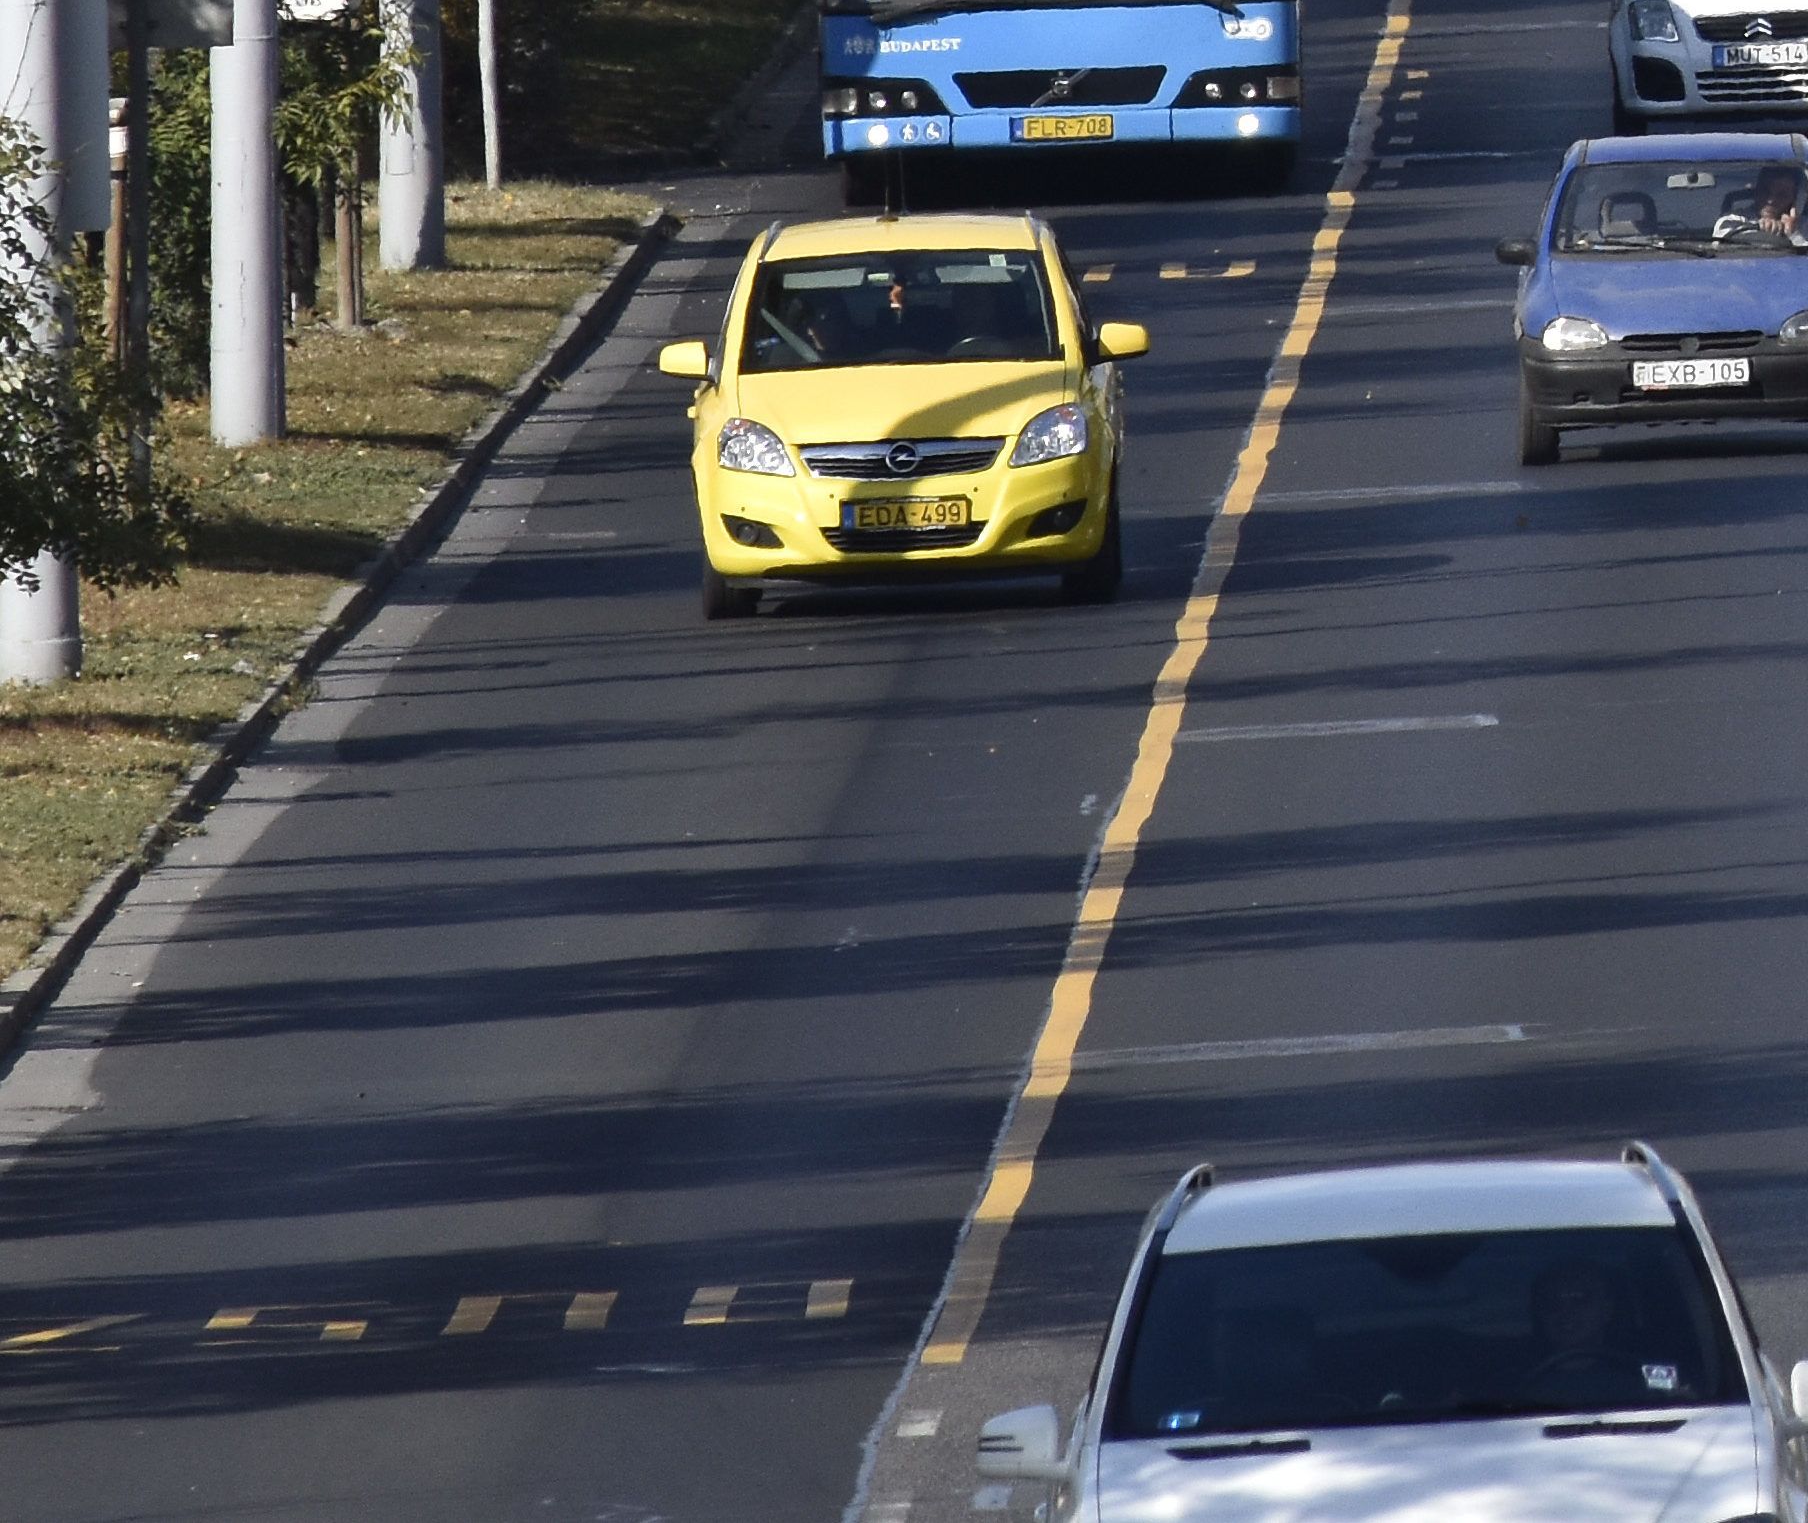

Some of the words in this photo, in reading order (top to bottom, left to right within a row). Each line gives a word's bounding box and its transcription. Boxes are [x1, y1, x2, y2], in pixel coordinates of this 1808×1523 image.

[879, 38, 961, 54] BUDAPEST
[1727, 46, 1804, 64] MUT-514
[1027, 117, 1107, 138] FLR-708
[1652, 361, 1745, 384] EXB-105
[858, 502, 961, 527] EDA-499
